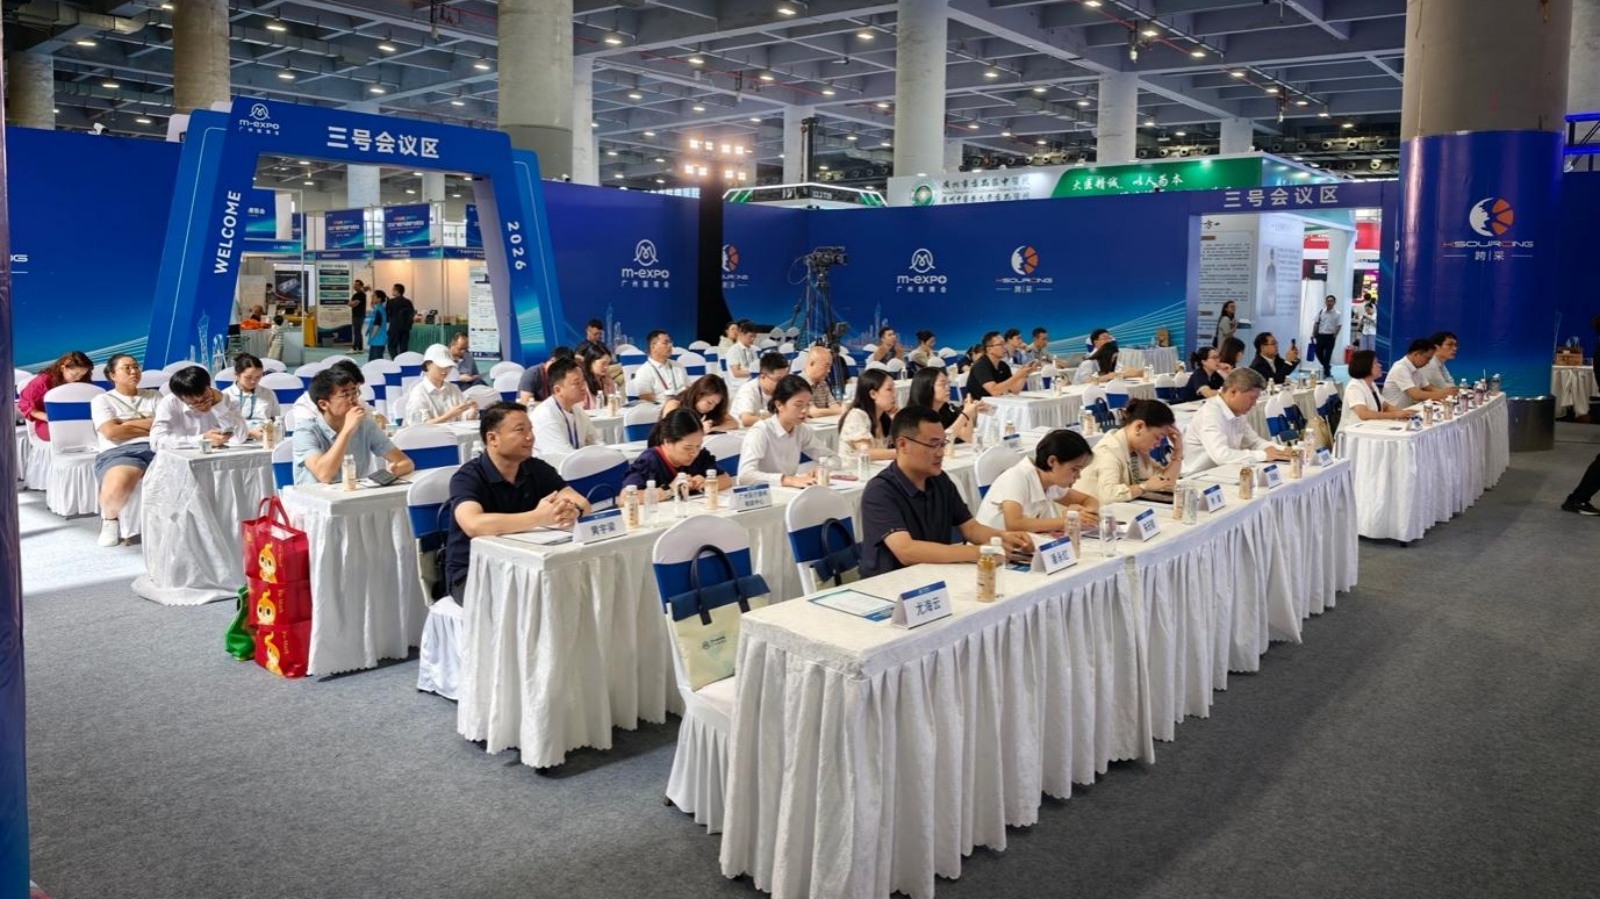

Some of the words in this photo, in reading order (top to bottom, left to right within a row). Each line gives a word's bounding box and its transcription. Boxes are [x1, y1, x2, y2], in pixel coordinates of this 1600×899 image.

[327, 126, 440, 158] 三号会议区
[1224, 185, 1338, 208] 三号会议区
[213, 190, 242, 274] WELCOME
[507, 221, 527, 270] 2026
[621, 268, 670, 279] m-expo
[897, 275, 948, 284] m-expo
